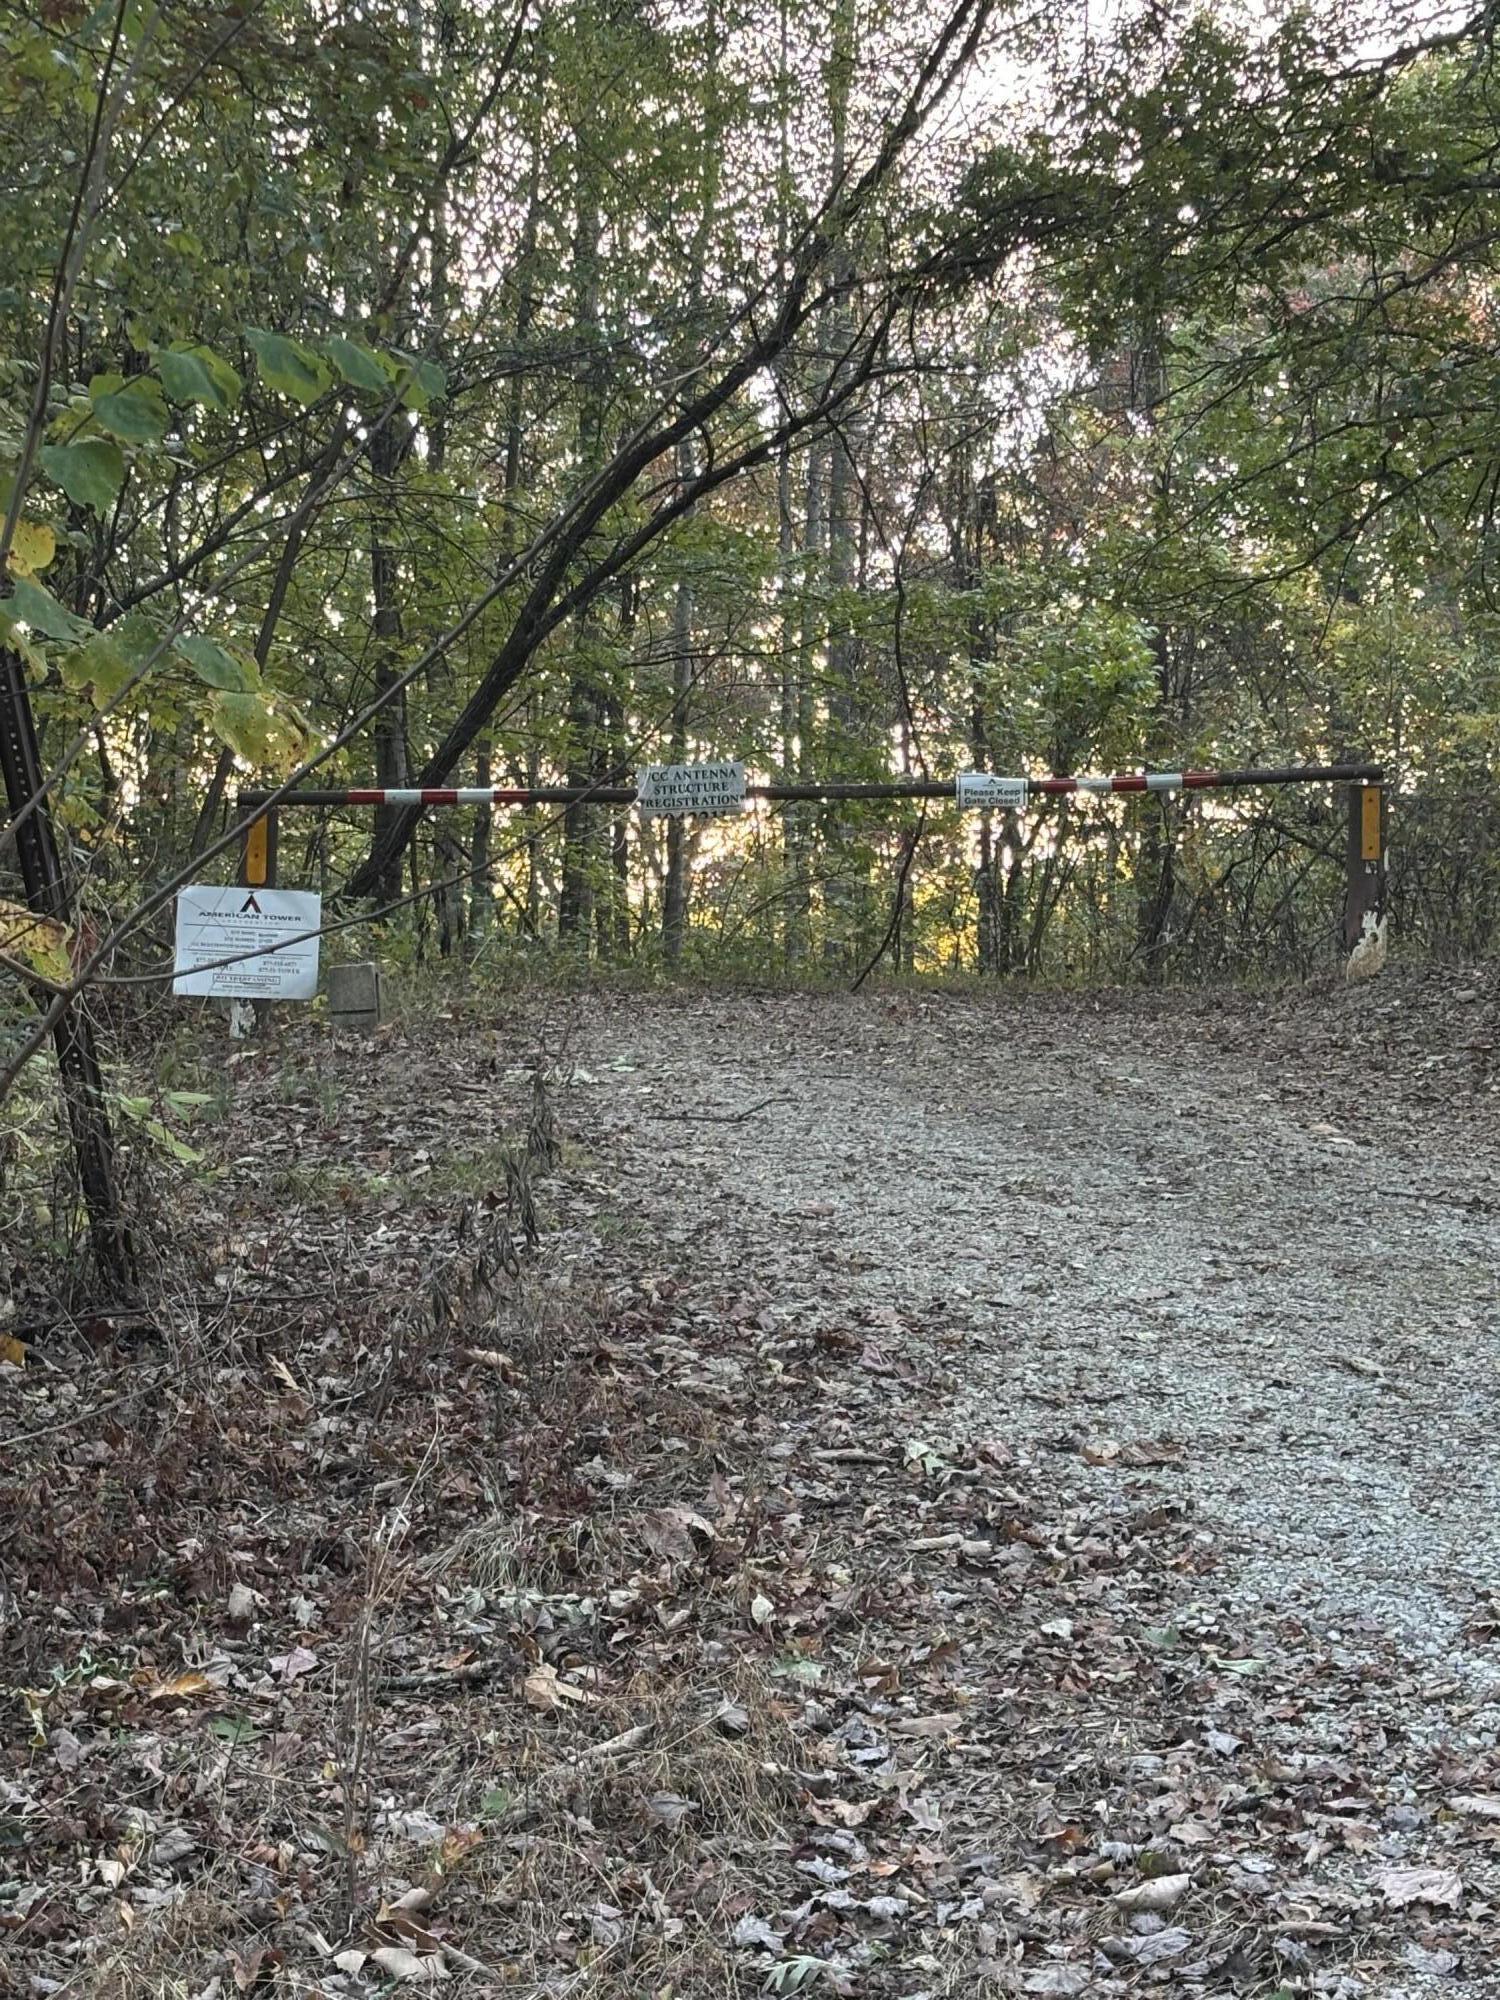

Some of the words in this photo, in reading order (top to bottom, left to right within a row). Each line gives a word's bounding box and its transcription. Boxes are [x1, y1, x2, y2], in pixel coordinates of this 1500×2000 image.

[673, 768, 737, 781] ANTENNA
[654, 781, 730, 795] STRUCTURE
[964, 788, 995, 796] Please
[997, 788, 1021, 797] Keep
[645, 794, 740, 808] REGISTRATION
[964, 797, 986, 805] Gate
[988, 797, 1020, 805] Closed
[199, 911, 260, 920] AMERICAN
[263, 913, 302, 921] TOWER
